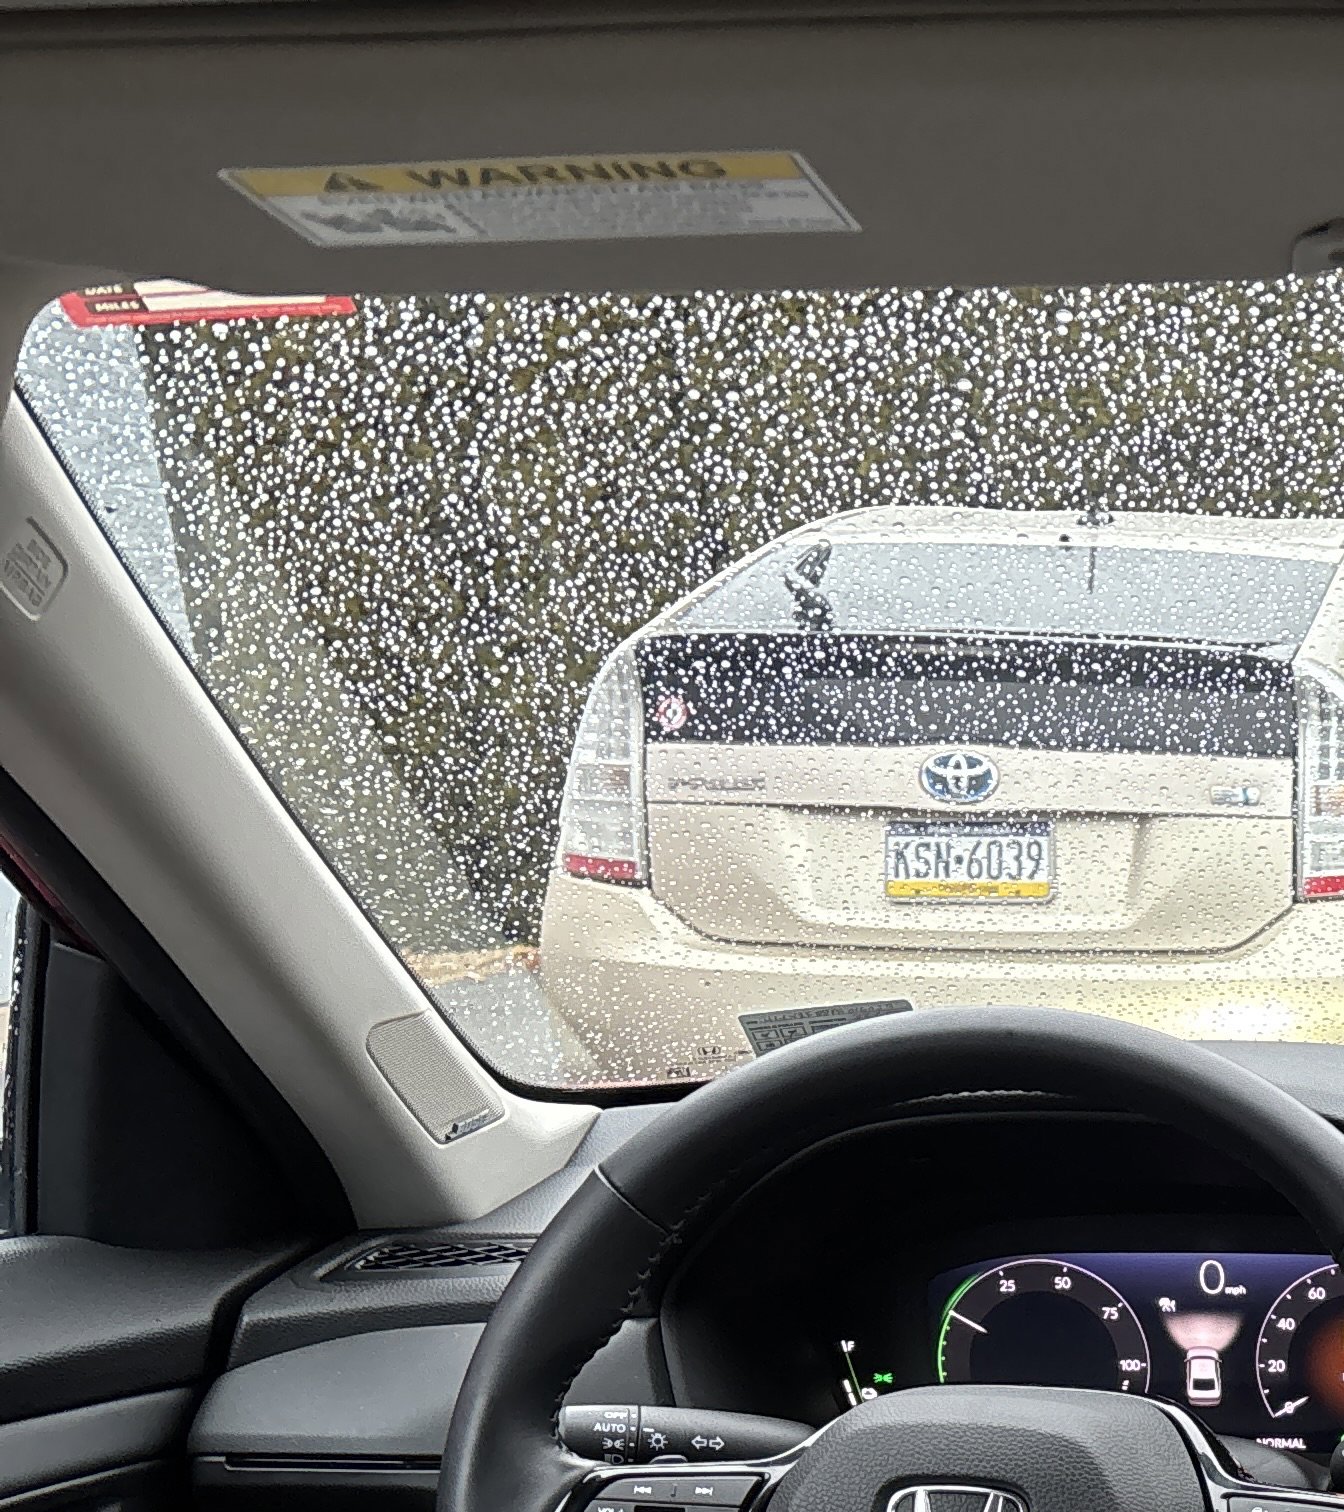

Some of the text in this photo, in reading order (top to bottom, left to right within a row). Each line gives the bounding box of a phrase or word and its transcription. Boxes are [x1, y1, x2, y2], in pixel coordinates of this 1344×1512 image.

[406, 158, 728, 190] WARNING
[1054, 1276, 1071, 1290] 50
[1199, 1260, 1248, 1297] 0 mph
[999, 1279, 1016, 1292] 25
[1308, 1287, 1326, 1300] 60
[1102, 1307, 1119, 1320] 75
[1277, 1318, 1296, 1331] 40
[1120, 1359, 1141, 1372] 100
[1268, 1359, 1286, 1372] 20
[604, 1411, 628, 1420] OFF
[594, 1423, 627, 1434] AUTO
[1256, 1437, 1307, 1450] NORMAL
